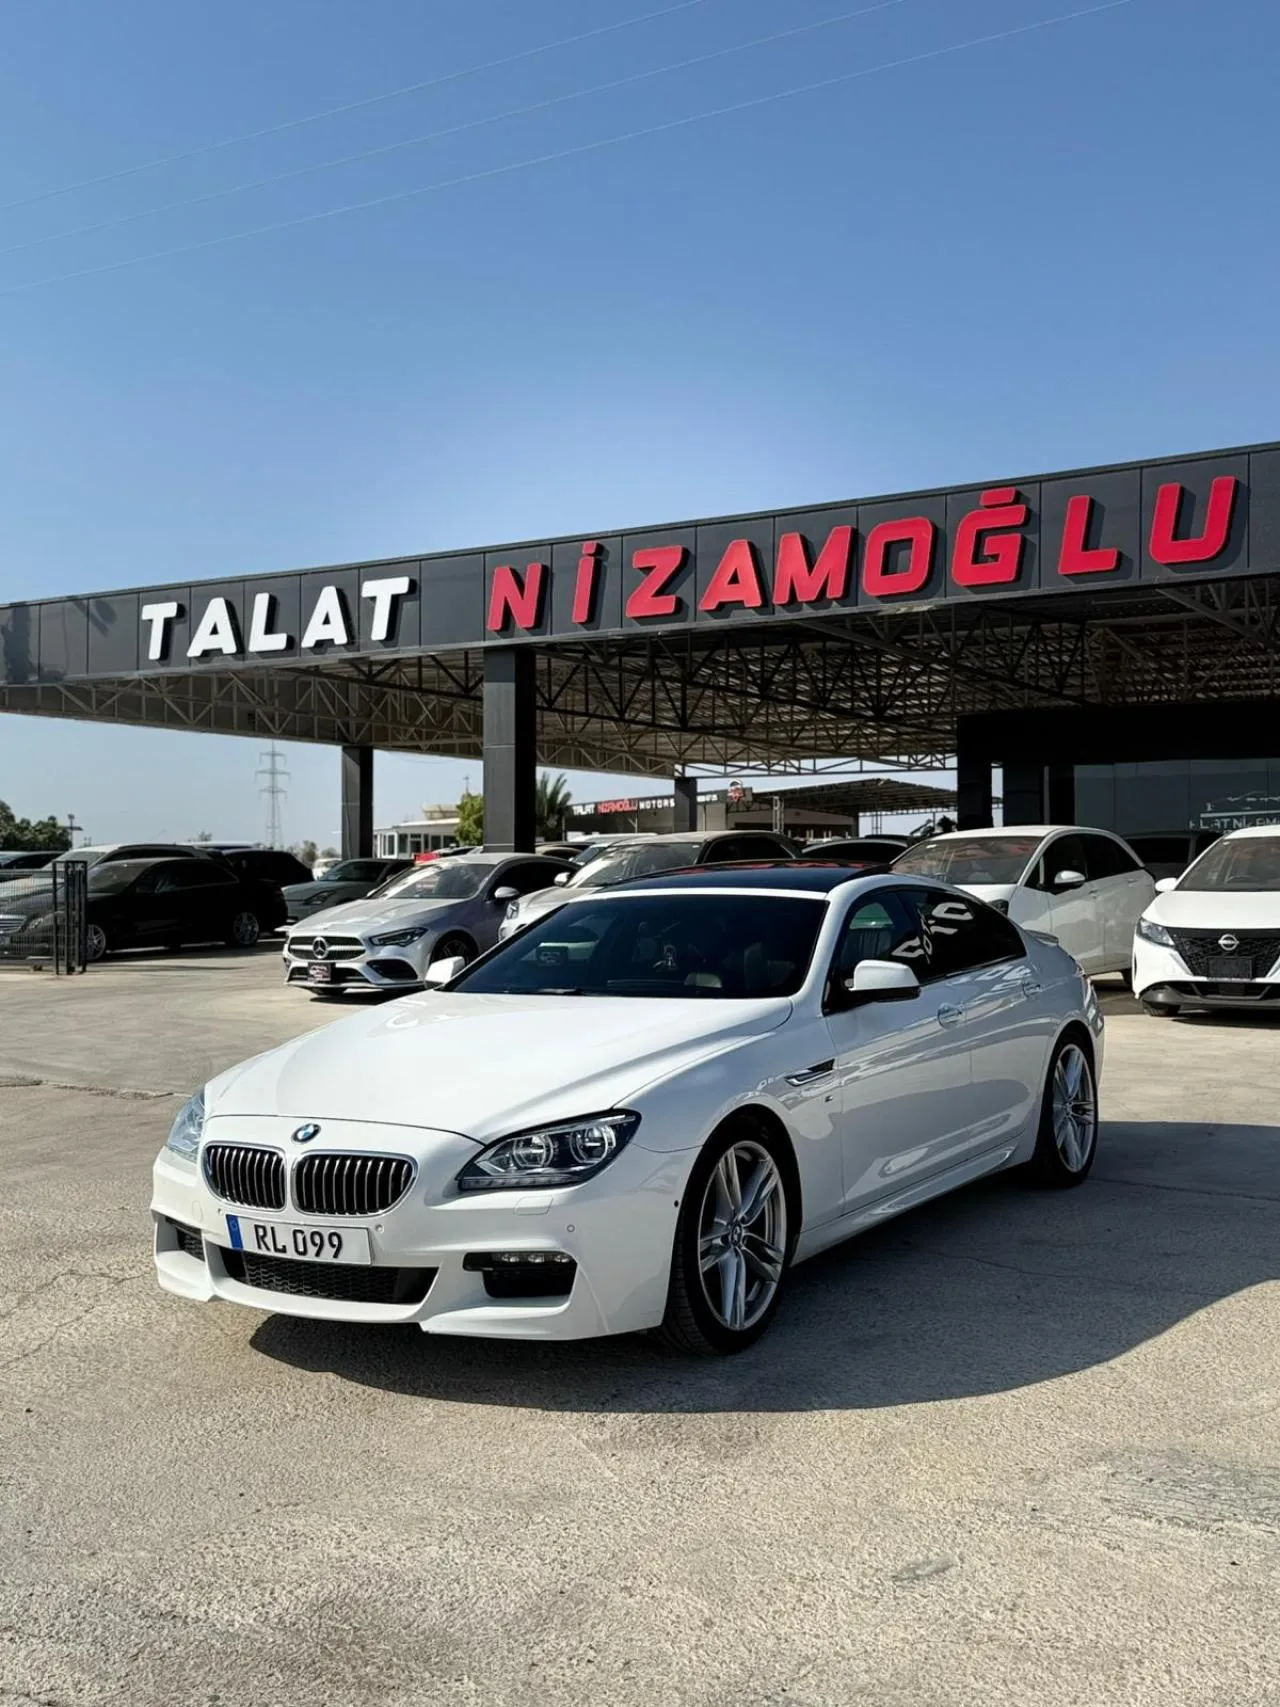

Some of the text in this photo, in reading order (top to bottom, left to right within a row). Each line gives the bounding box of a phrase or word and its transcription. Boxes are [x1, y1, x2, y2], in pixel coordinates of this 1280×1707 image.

[142, 476, 1237, 660] TALAT NİZAMOĞLU
[639, 798, 675, 809] MOTORS
[254, 1224, 343, 1258] RL 099
